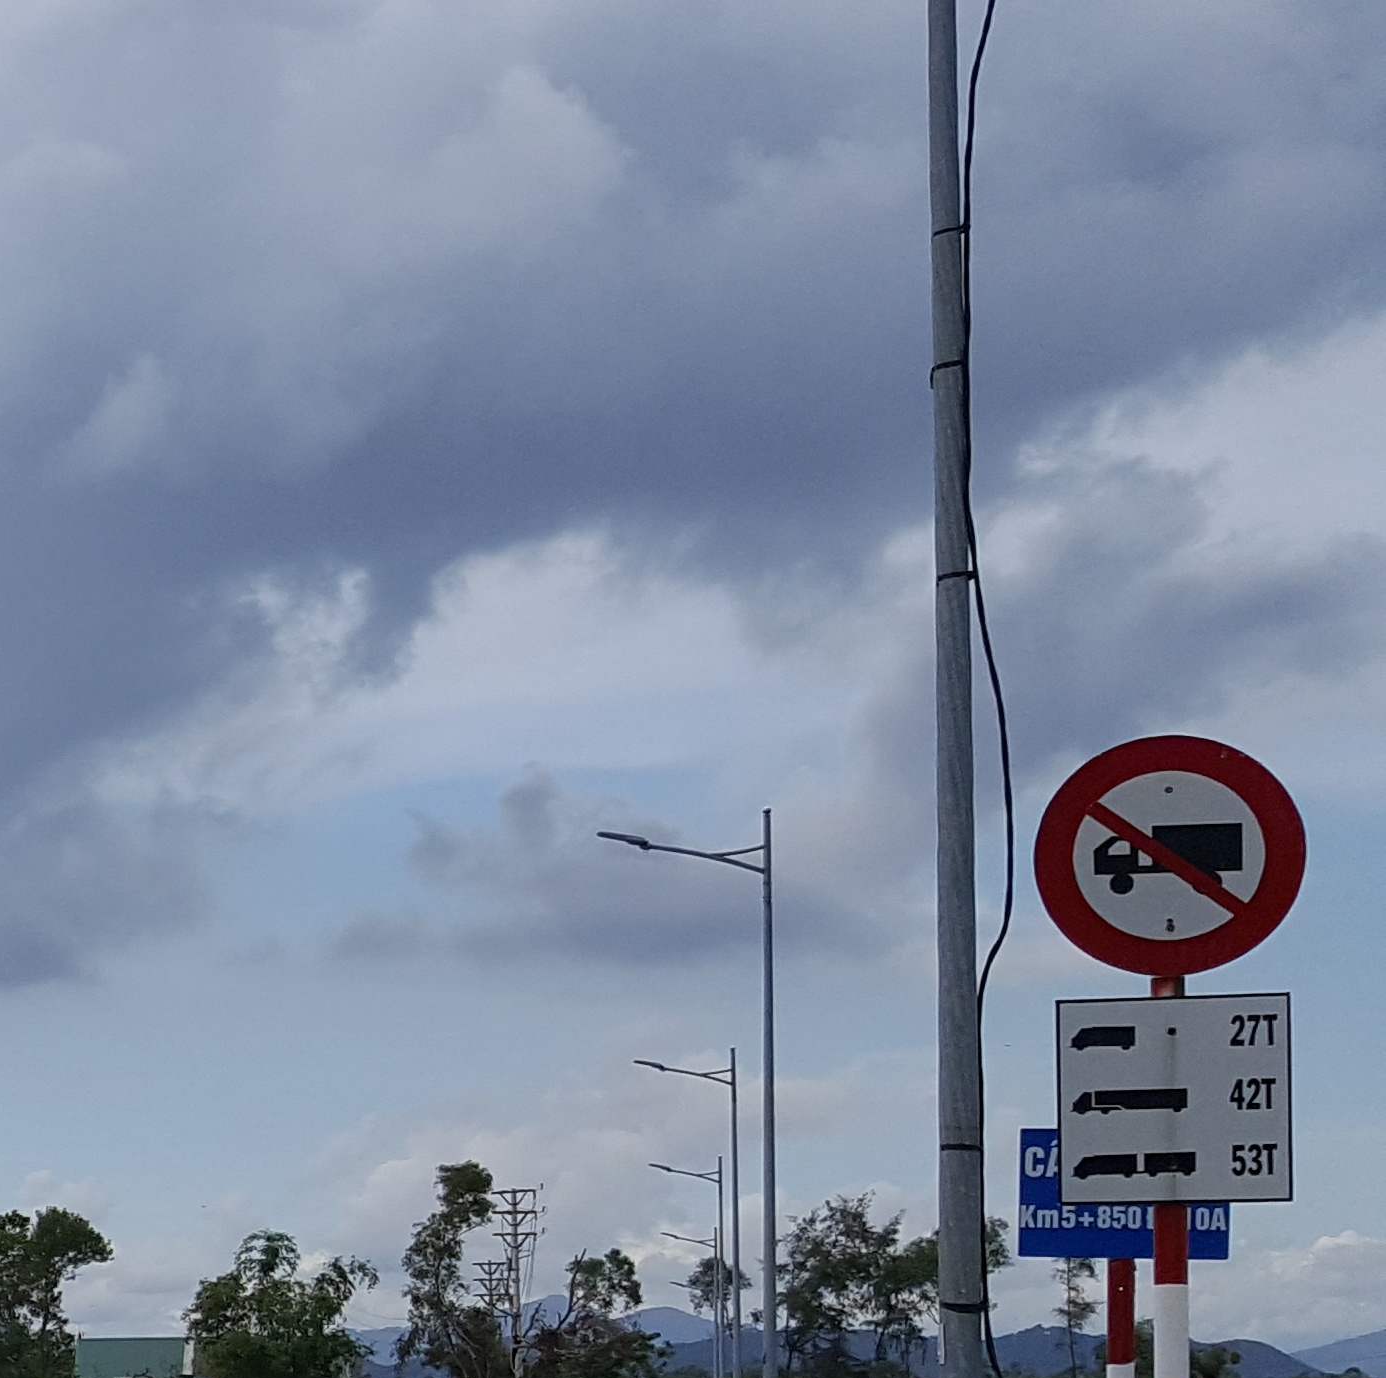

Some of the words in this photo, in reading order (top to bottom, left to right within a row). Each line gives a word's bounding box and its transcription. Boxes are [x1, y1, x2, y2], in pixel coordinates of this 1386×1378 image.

[1229, 1013, 1278, 1047] 27T
[1229, 1077, 1277, 1111] 42T
[1230, 1142, 1278, 1177] 53T
[1019, 1204, 1138, 1230] Km5+850
